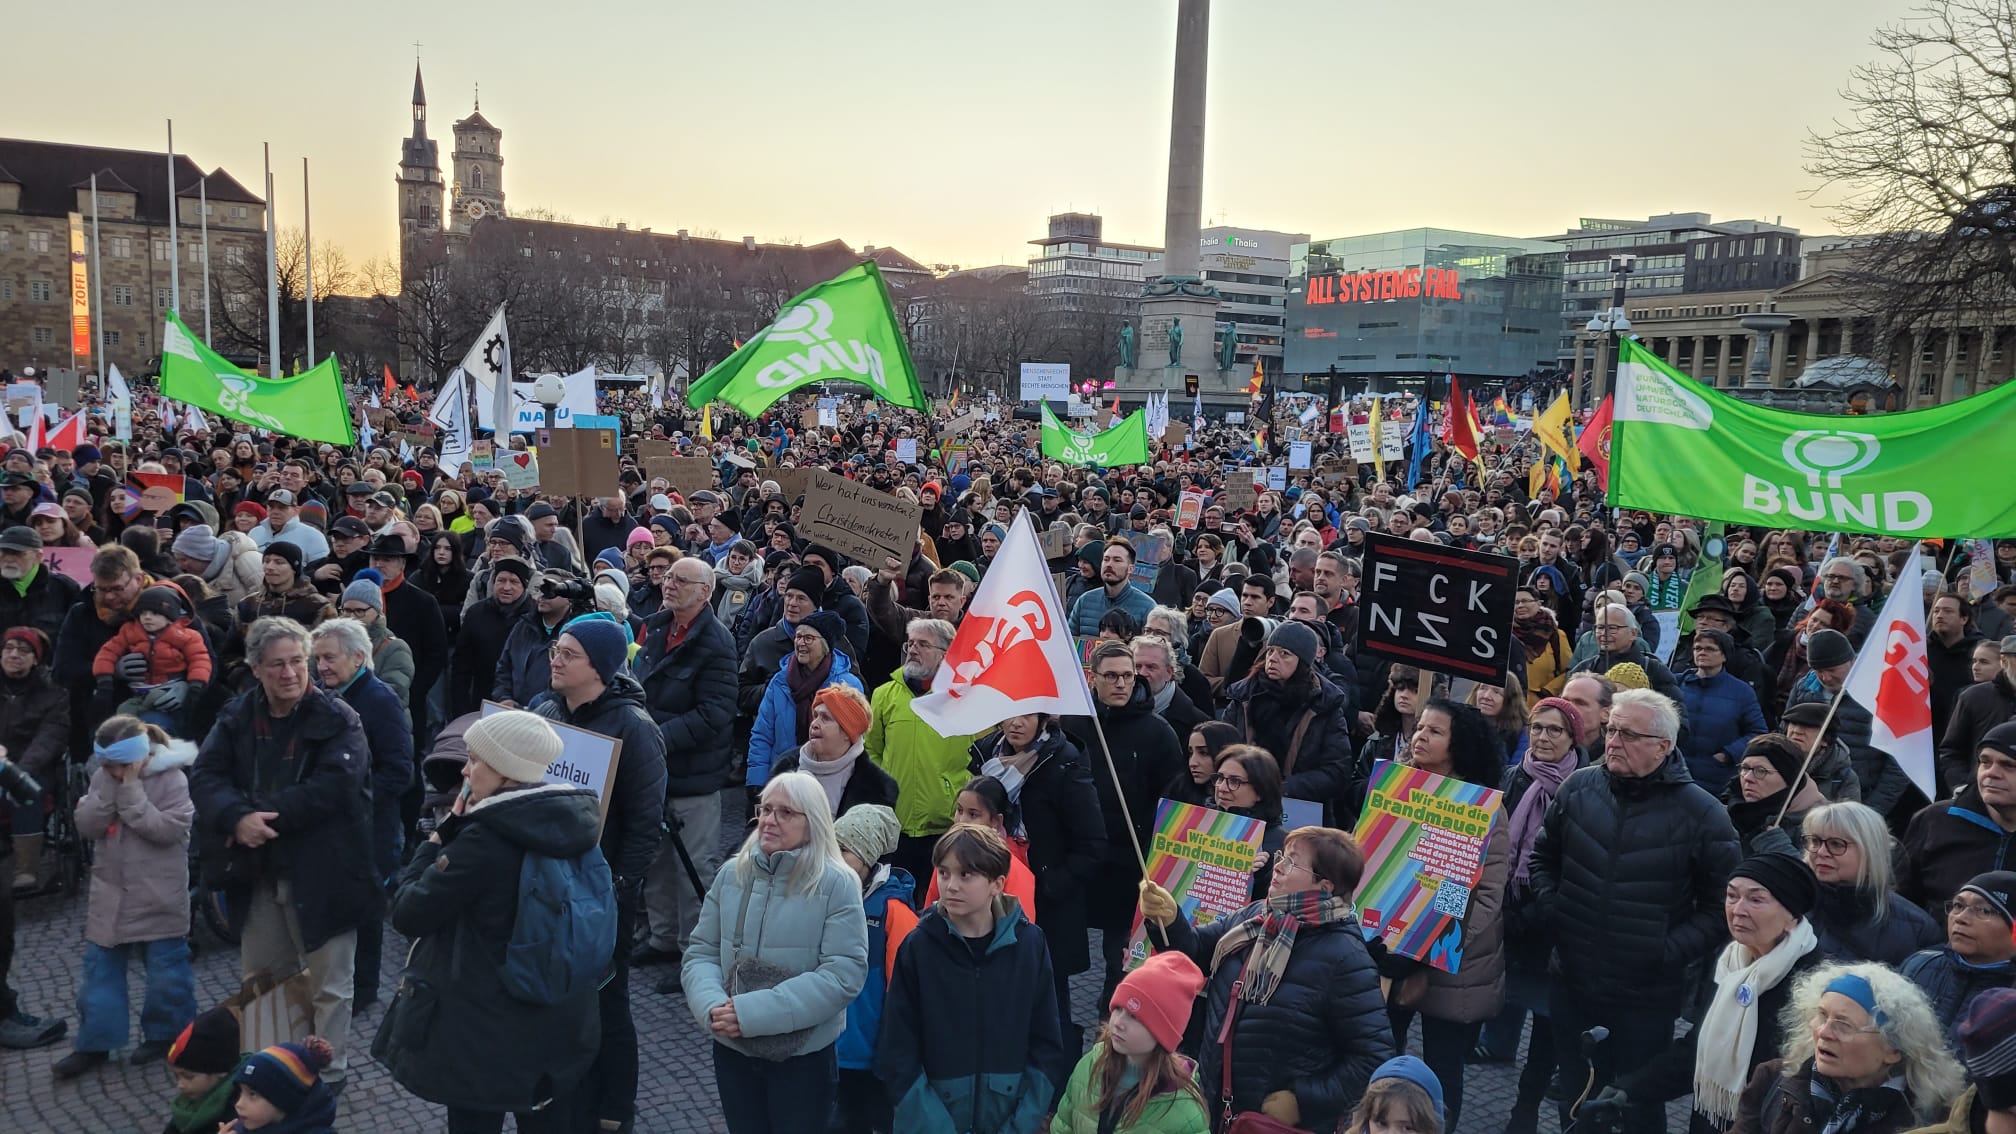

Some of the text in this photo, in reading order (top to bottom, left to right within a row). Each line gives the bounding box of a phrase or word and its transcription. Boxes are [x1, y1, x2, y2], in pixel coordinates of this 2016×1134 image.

[1200, 236, 1219, 246] Thalia
[1234, 237, 1258, 248] Thalia
[1307, 267, 1462, 305] ALL SYSTEMS FAIL
[519, 408, 569, 422] NAU
[1062, 446, 1108, 463] BUND
[816, 474, 834, 490] Wer
[837, 481, 860, 500] hat
[862, 495, 877, 507] uns
[1743, 473, 1933, 531] BUND
[800, 524, 812, 534] Nie
[814, 530, 834, 542] wieder
[836, 536, 848, 548] ist
[1374, 562, 1492, 614] FCK
[546, 761, 591, 786] schlau
[1371, 793, 1486, 837] Brandmauer
[1411, 790, 1489, 822] Wir sind die
[1189, 831, 1254, 857] Wir sind die
[1421, 823, 1484, 846] Gemeinsam für
[1156, 836, 1253, 871] Brandmauer
[1417, 846, 1478, 869] und den Schutz
[1419, 838, 1479, 862] Zusammenhalt
[1197, 861, 1250, 880] Gemeinsam für
[1408, 851, 1475, 875] unserer Lebens-
[1424, 864, 1473, 884] grundlagen.
[1193, 884, 1245, 902] und den Schutz
[1196, 875, 1247, 895] Zusammenhalt
[1186, 890, 1243, 909] unserer Lebens-
